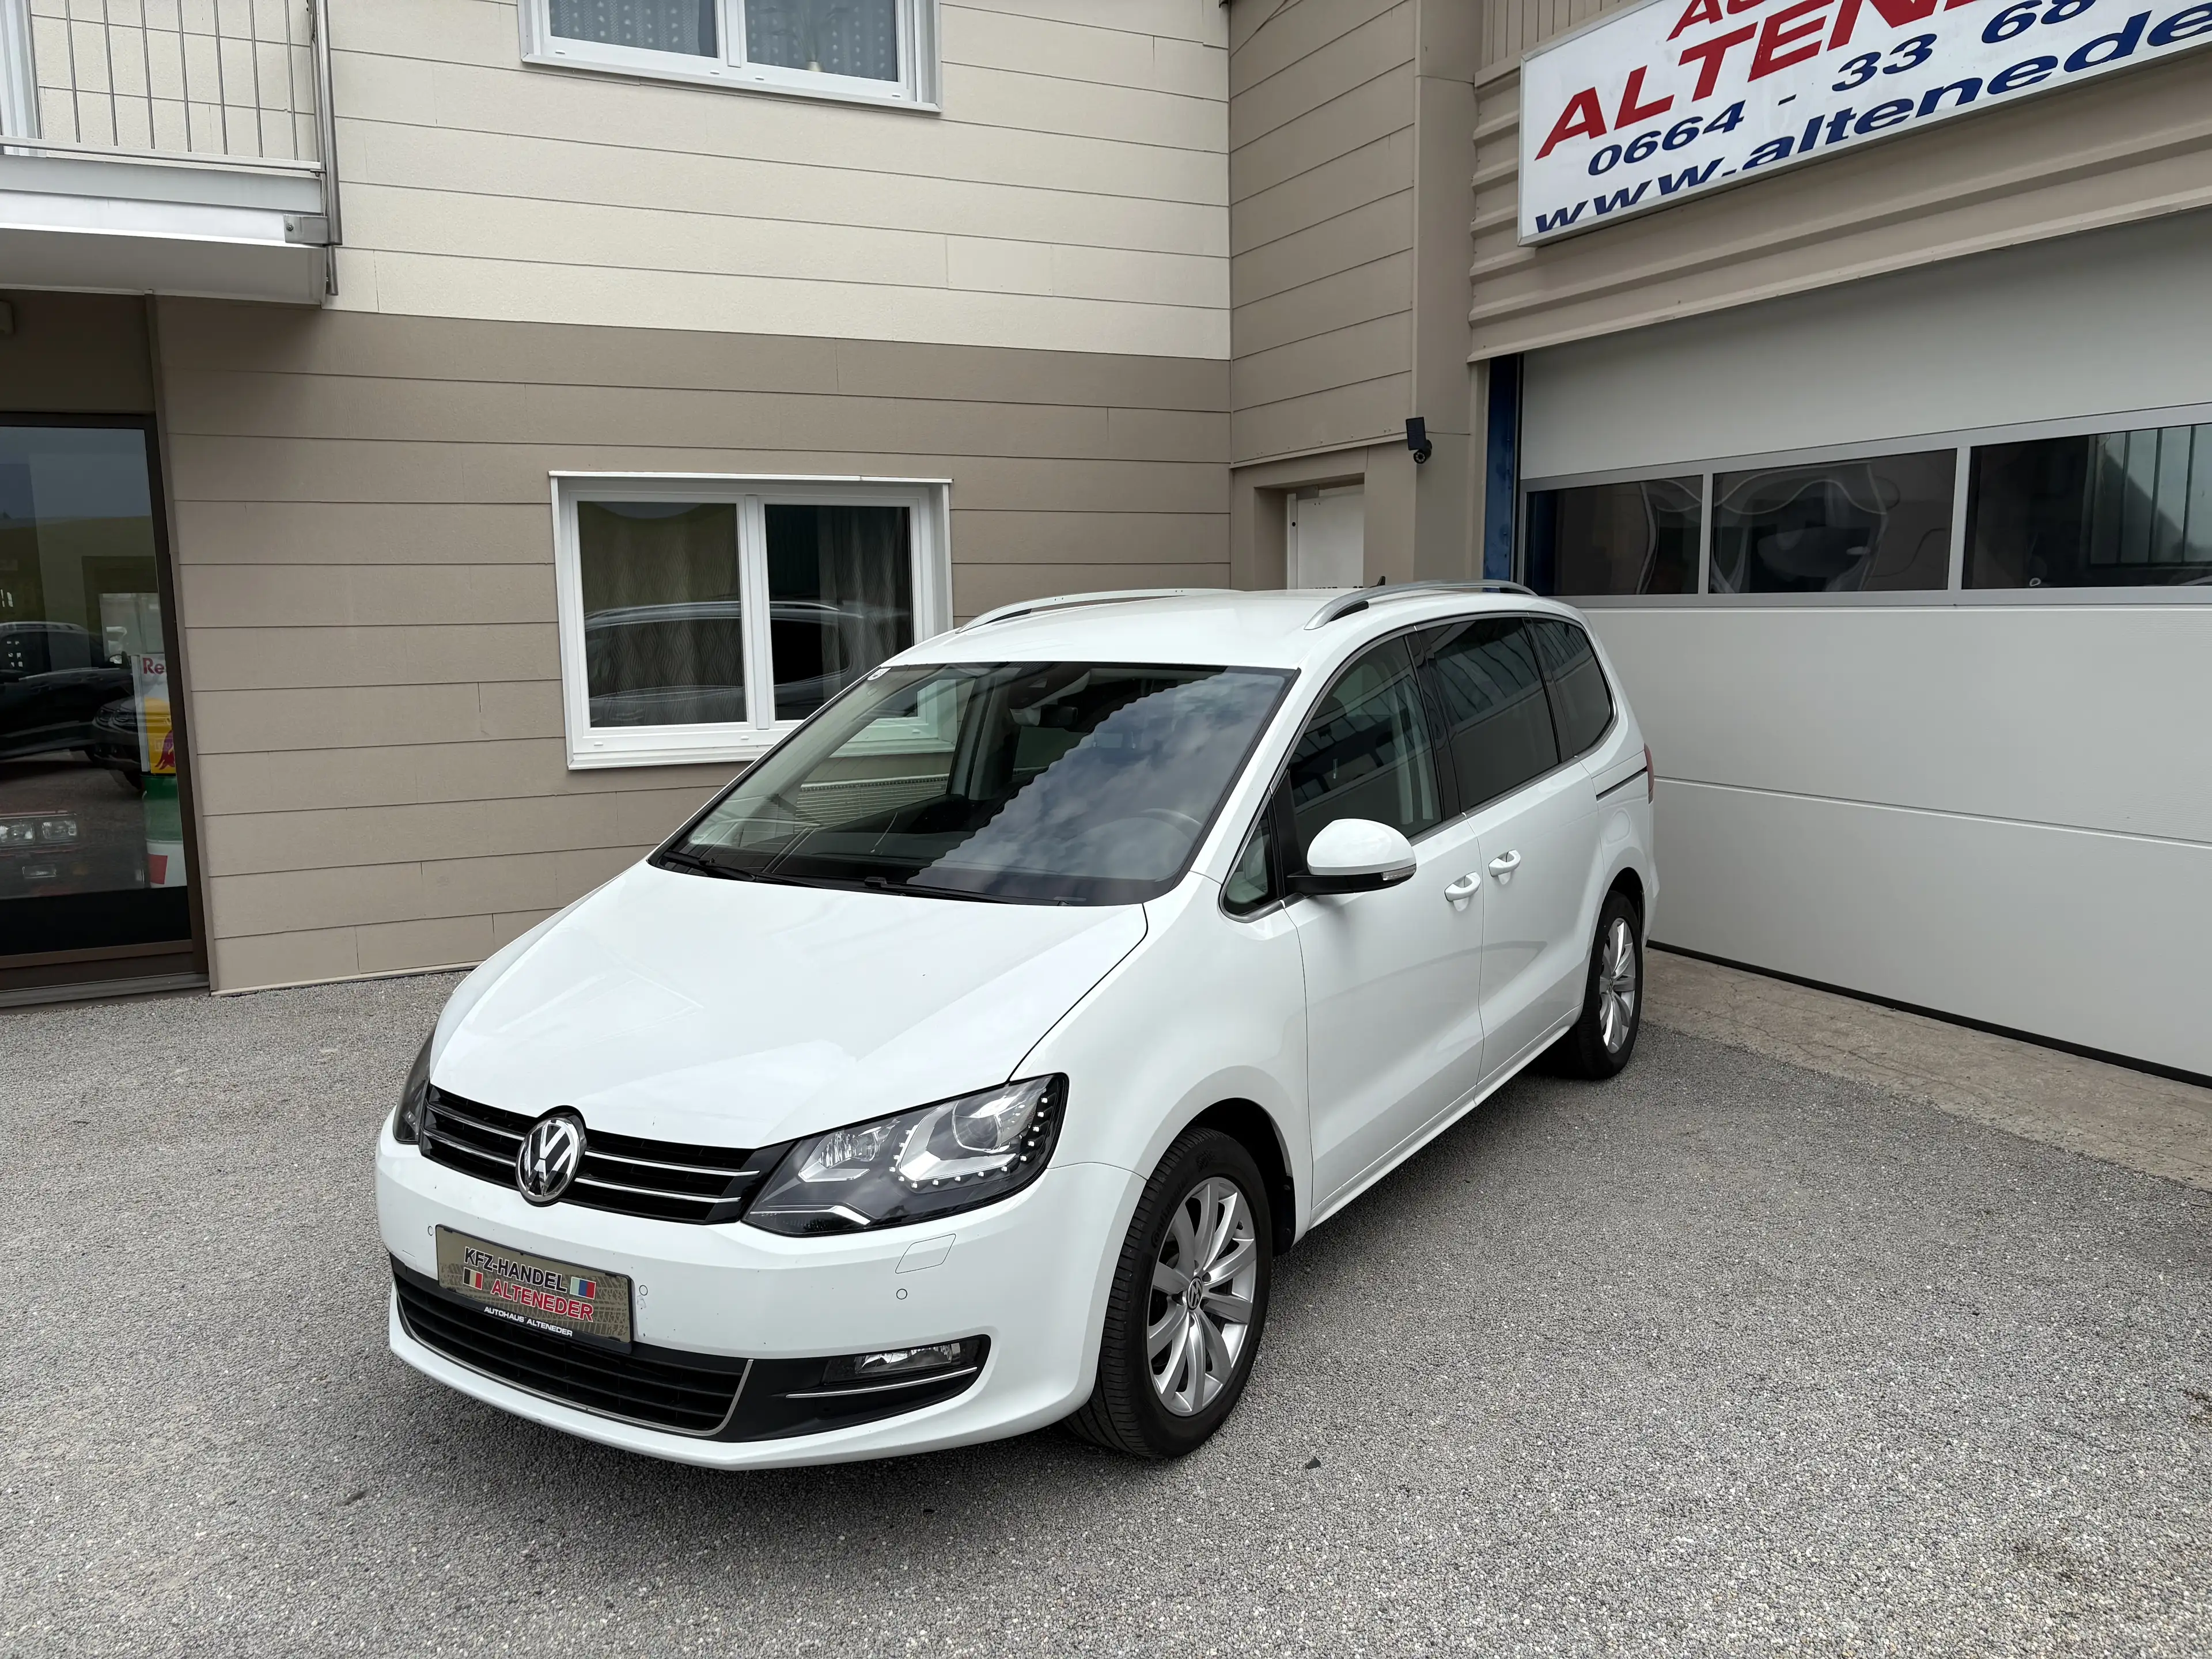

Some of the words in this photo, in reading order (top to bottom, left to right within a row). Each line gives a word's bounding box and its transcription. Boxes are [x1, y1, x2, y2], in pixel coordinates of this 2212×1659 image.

[1535, 0, 1975, 160] ALTEN
[1588, 100, 1746, 175] 0664
[1832, 33, 1937, 92] 33
[464, 1247, 567, 1293] KFZ-HANDEL
[484, 1306, 525, 1323] AUTOHAUS
[527, 1319, 573, 1337] ALTENEDER
[491, 1278, 594, 1323] ALTENEDER
